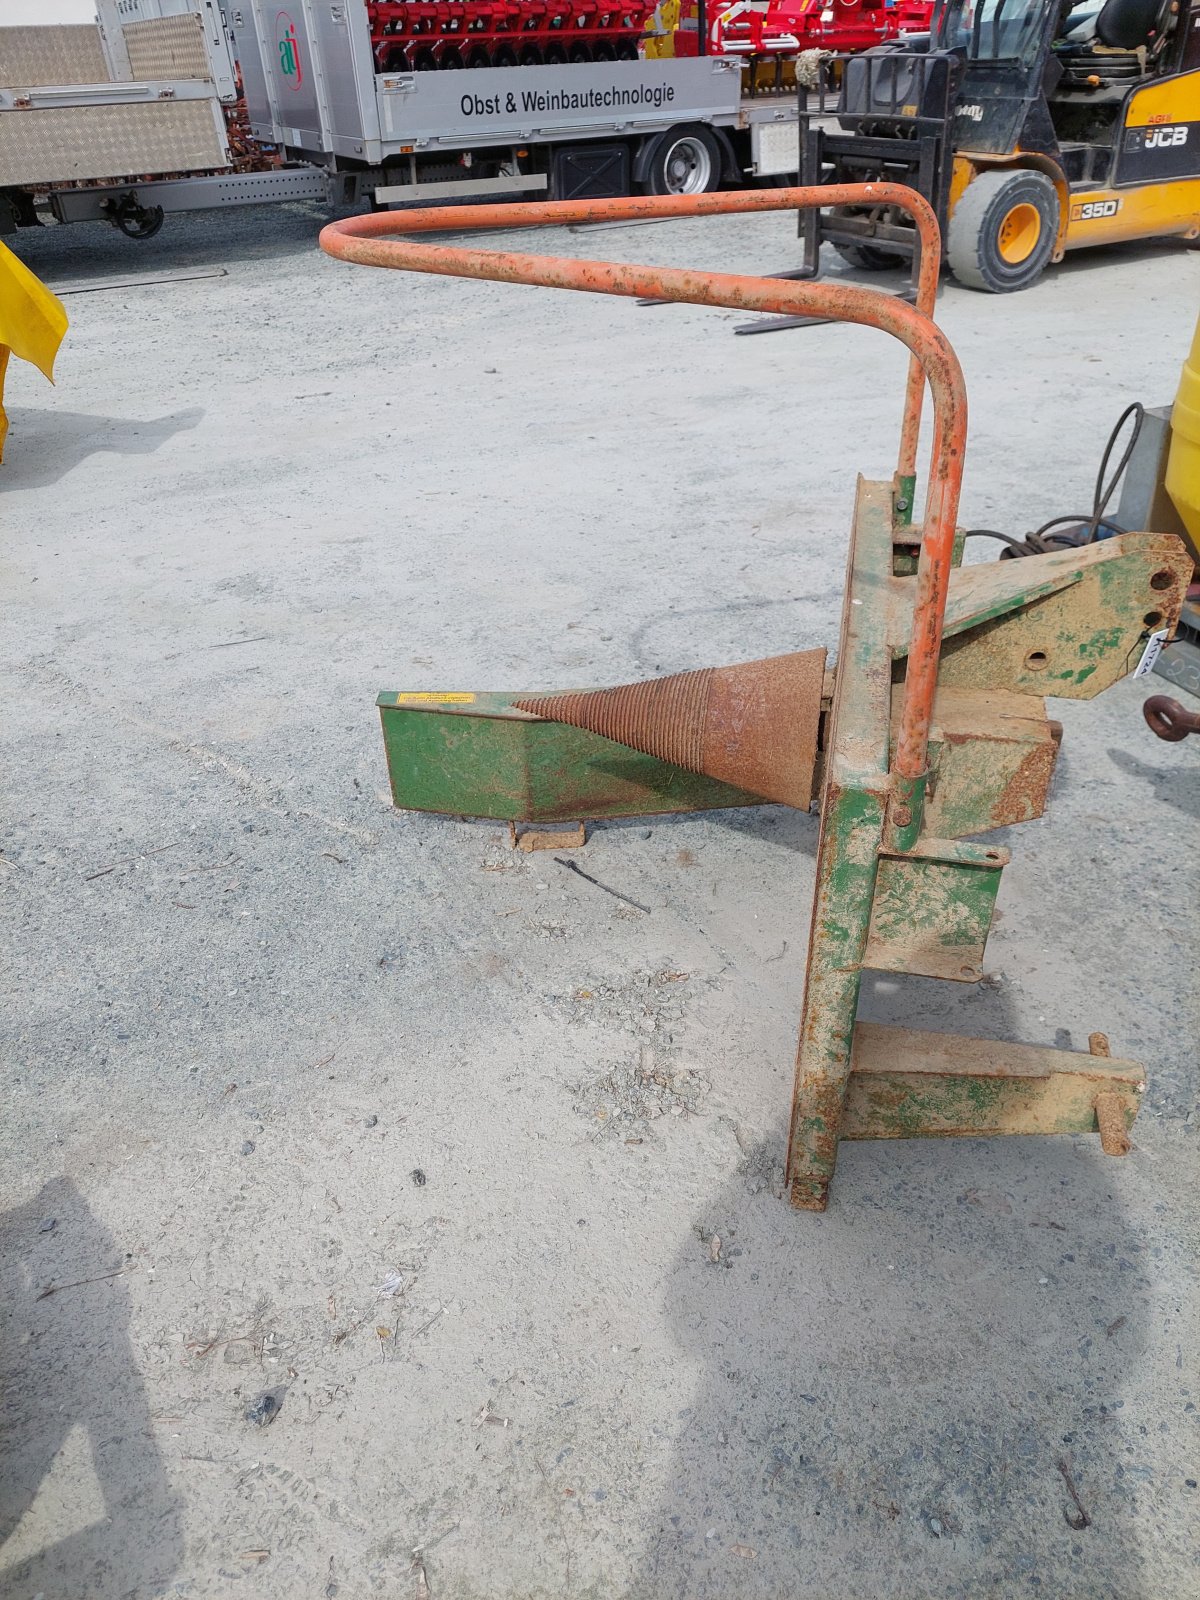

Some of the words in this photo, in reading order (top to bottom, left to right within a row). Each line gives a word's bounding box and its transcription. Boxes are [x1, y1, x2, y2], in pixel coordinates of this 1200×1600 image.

[461, 92, 501, 116] Obst
[505, 92, 517, 113] &
[521, 82, 675, 112] Weinbautechnologie
[1145, 126, 1189, 148] JCB
[1082, 200, 1117, 219] 35D
